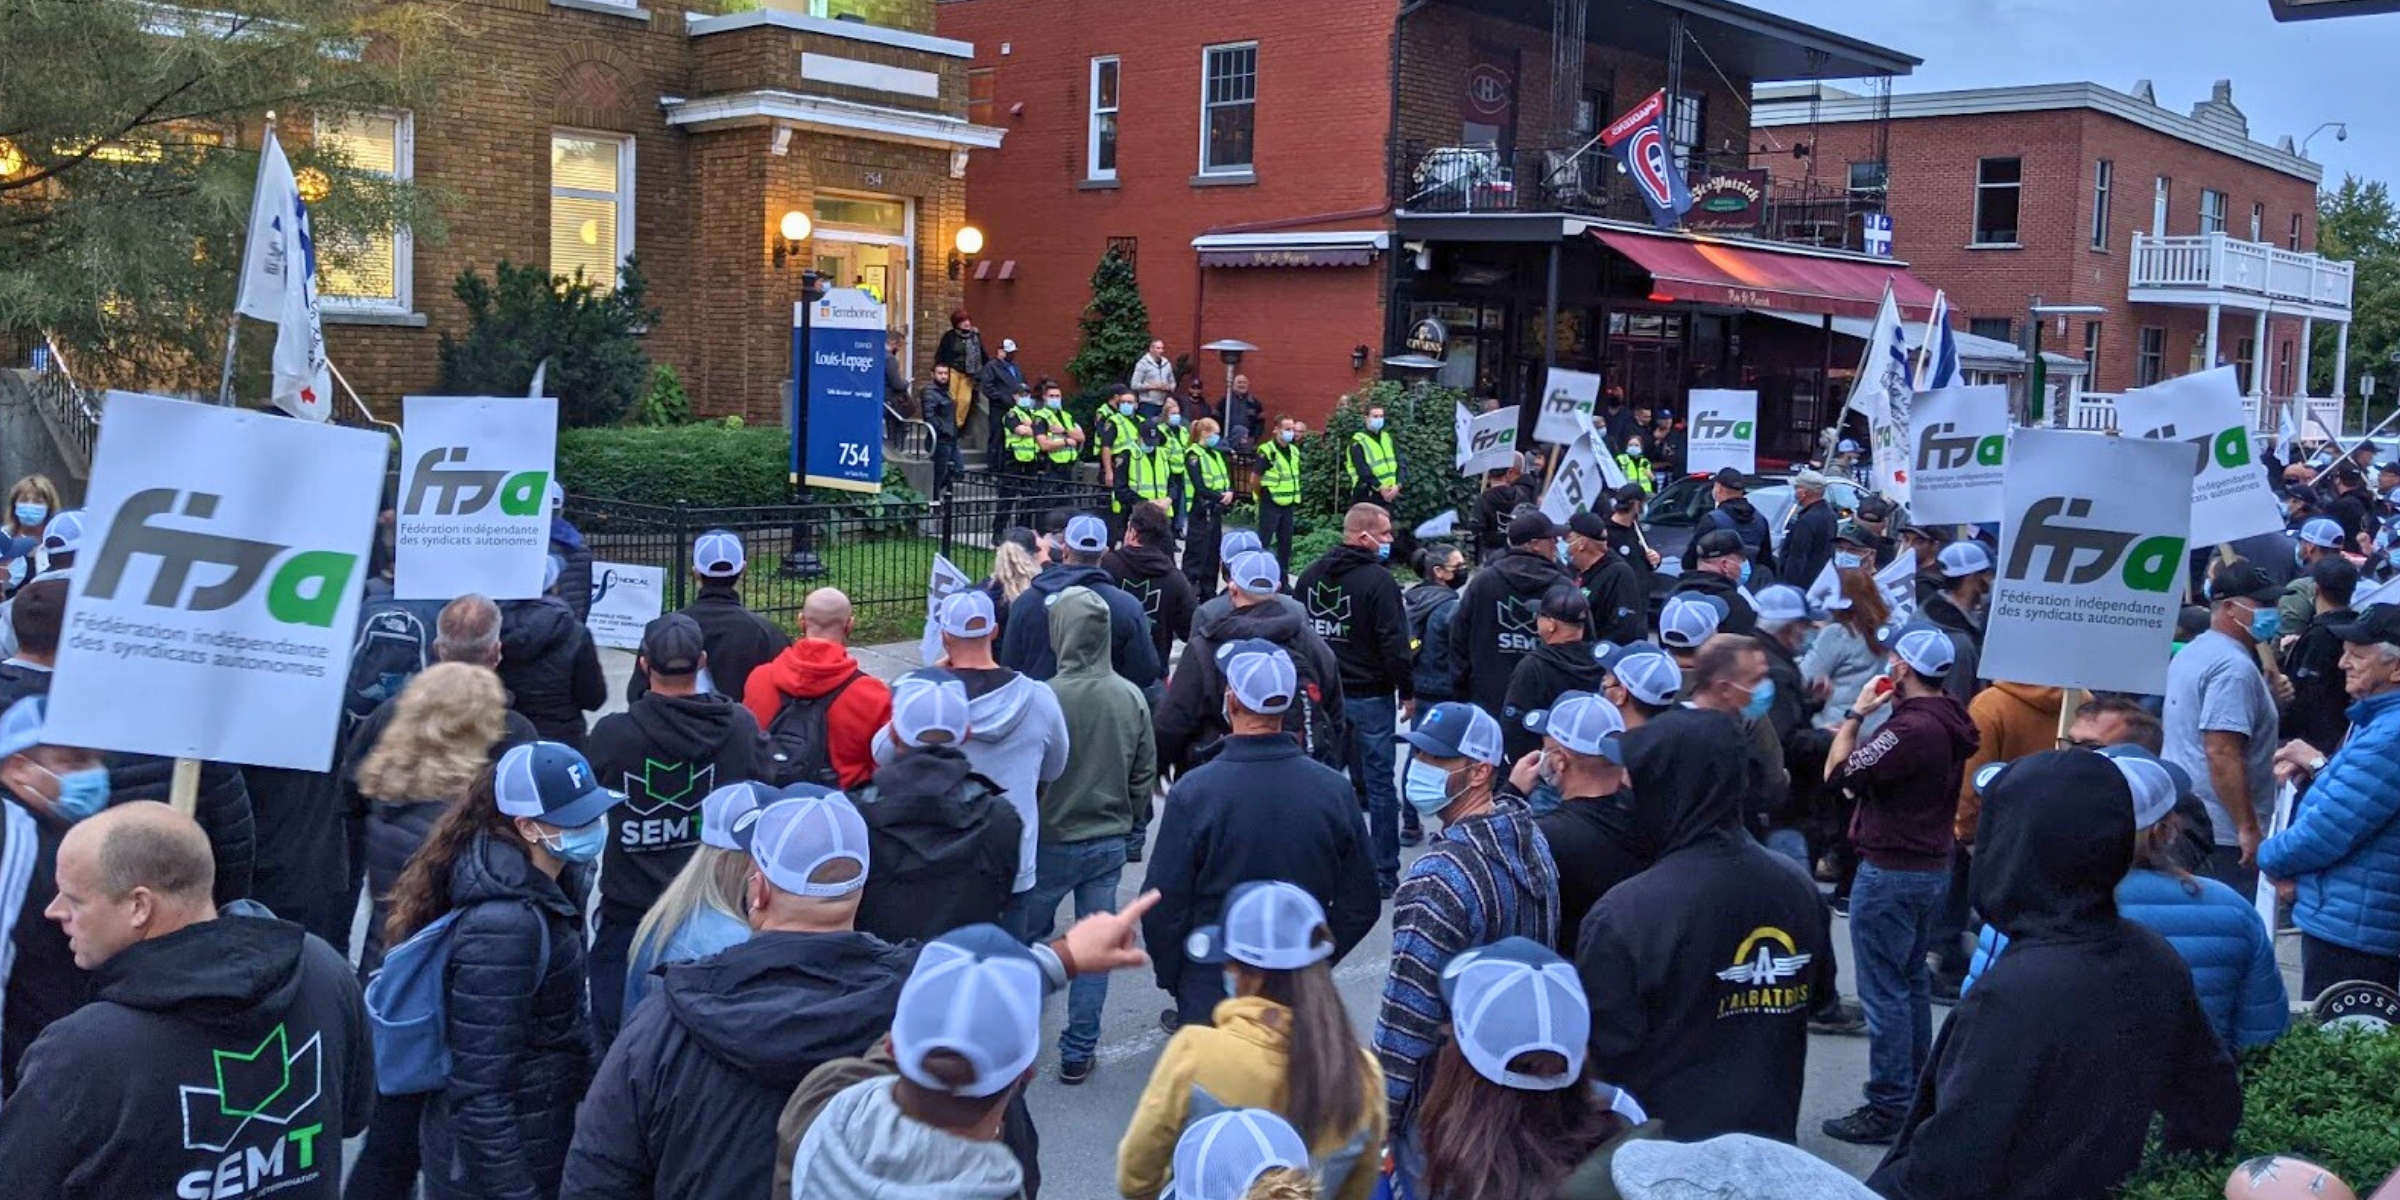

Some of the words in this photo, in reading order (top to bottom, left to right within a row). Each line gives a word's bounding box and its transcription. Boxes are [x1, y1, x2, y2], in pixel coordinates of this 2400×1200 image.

[831, 305, 878, 319] Terrebonne
[815, 350, 874, 373] Louis-Lepage
[839, 442, 870, 468] 754
[2209, 481, 2260, 499] autonomes
[400, 523, 459, 535] Fédération
[463, 523, 539, 536] indépendante
[400, 535, 418, 546] des
[422, 535, 471, 548] syndicats
[475, 536, 538, 546] autonomes
[2000, 588, 2070, 607] Fédération
[2075, 593, 2165, 616] indépendante
[1997, 603, 2020, 618] des
[2025, 606, 2084, 622] syndicats
[2088, 612, 2163, 629] autonomes
[72, 610, 188, 642] Fédération
[192, 626, 329, 659] indépendante
[67, 632, 104, 653] des
[112, 637, 207, 665] syndicats
[213, 650, 326, 678] autonomes
[2331, 992, 2398, 1016] GOOSE
[176, 1122, 323, 1200] SEMT
